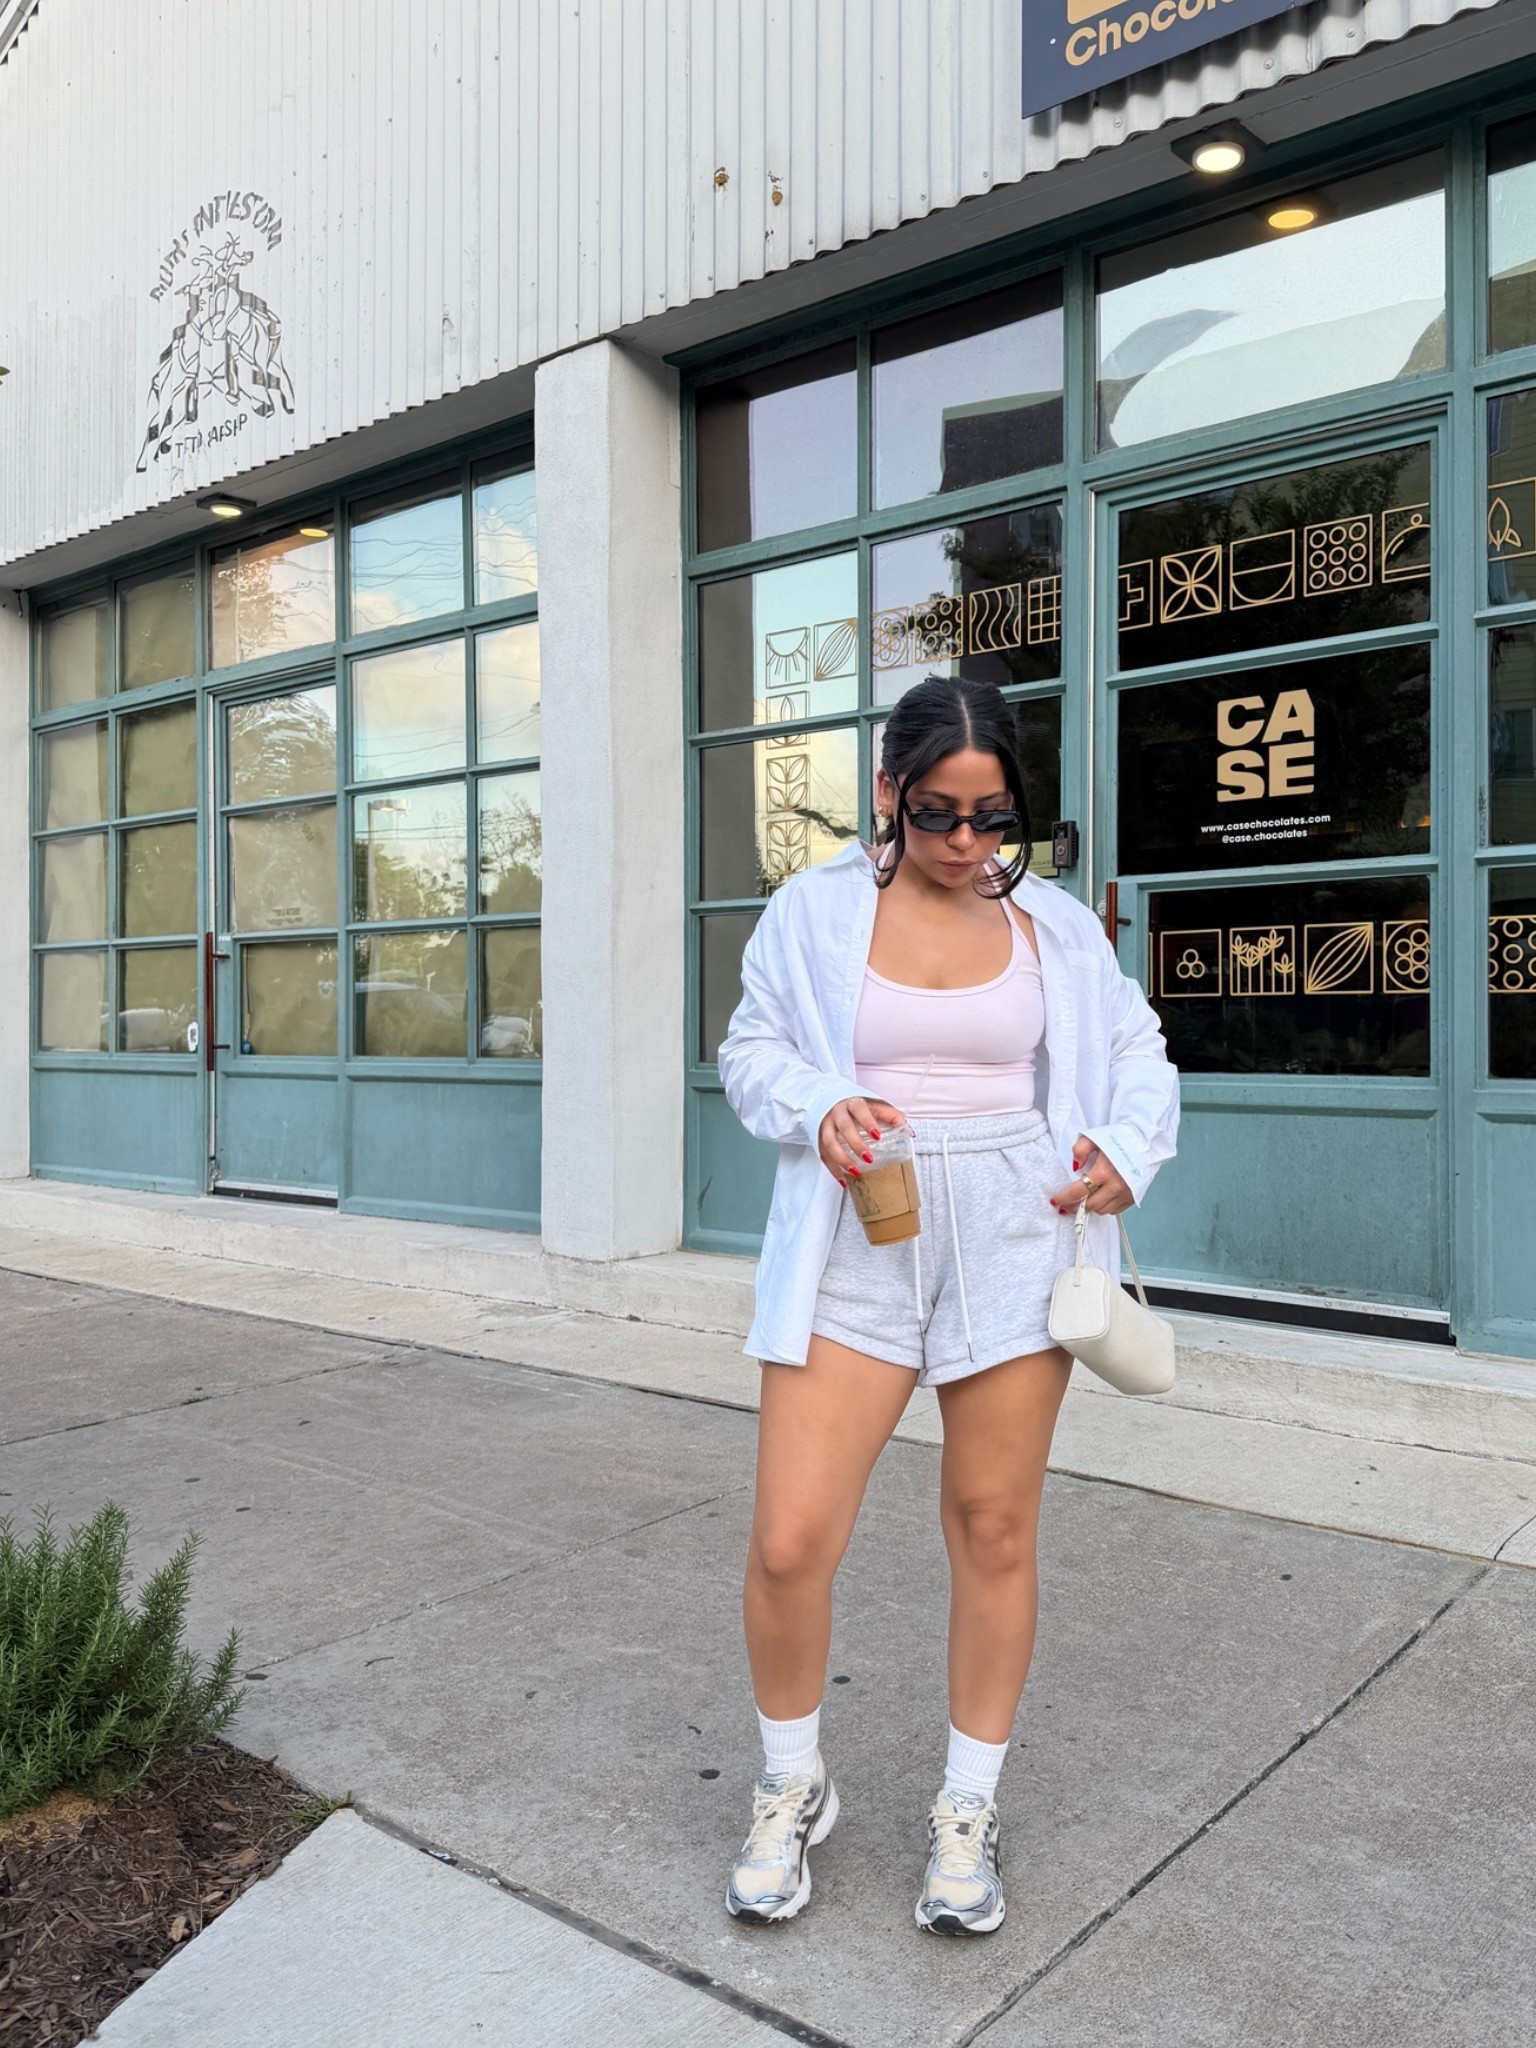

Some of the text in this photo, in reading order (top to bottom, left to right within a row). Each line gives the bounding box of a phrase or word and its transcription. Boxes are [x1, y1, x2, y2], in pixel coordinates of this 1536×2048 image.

[1065, 0, 1236, 66] Choco
[1200, 814, 1331, 833] www.casechocolates.com
[1221, 829, 1308, 844] @case.chocolates
